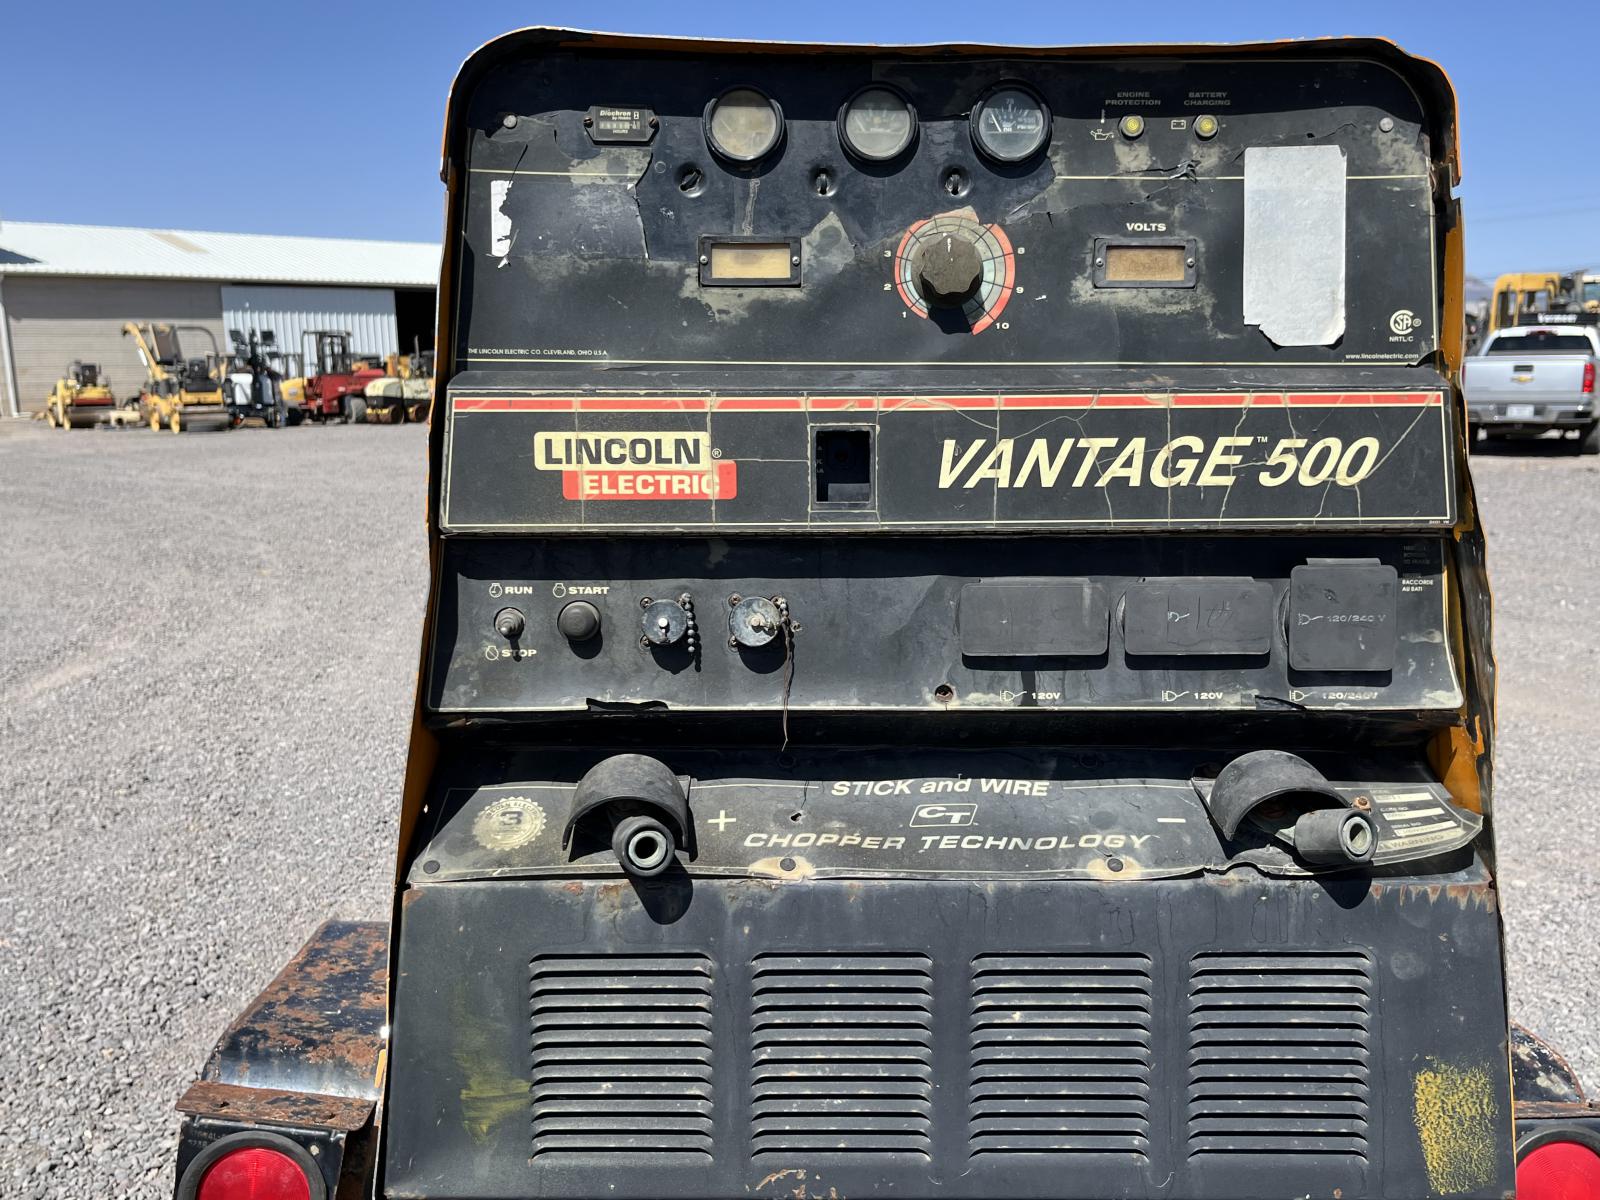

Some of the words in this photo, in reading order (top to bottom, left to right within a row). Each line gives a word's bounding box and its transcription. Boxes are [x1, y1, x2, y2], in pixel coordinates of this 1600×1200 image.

[1126, 222, 1167, 232] VOLTS
[883, 250, 892, 258] 3
[1017, 247, 1026, 255] 8
[883, 283, 892, 291] 2
[1016, 286, 1024, 294] 9
[902, 311, 907, 319] 1
[996, 322, 1010, 330] 10
[545, 438, 701, 465] LINCOLN
[938, 437, 1256, 489] VANTAGE
[1258, 437, 1380, 487] 500
[584, 475, 720, 495] ELECTRIC
[505, 587, 533, 595] RUN
[568, 587, 610, 595] START
[502, 649, 537, 658] STOP
[1031, 692, 1061, 700] 120V
[1195, 692, 1224, 700] 120V
[831, 781, 914, 796] STICK
[920, 779, 972, 793] and
[980, 779, 1049, 797] WIRE
[500, 811, 523, 825] 3
[918, 806, 970, 824] CT
[743, 833, 906, 850] CHOPPER
[921, 834, 1151, 850] TECHNOLOGY
